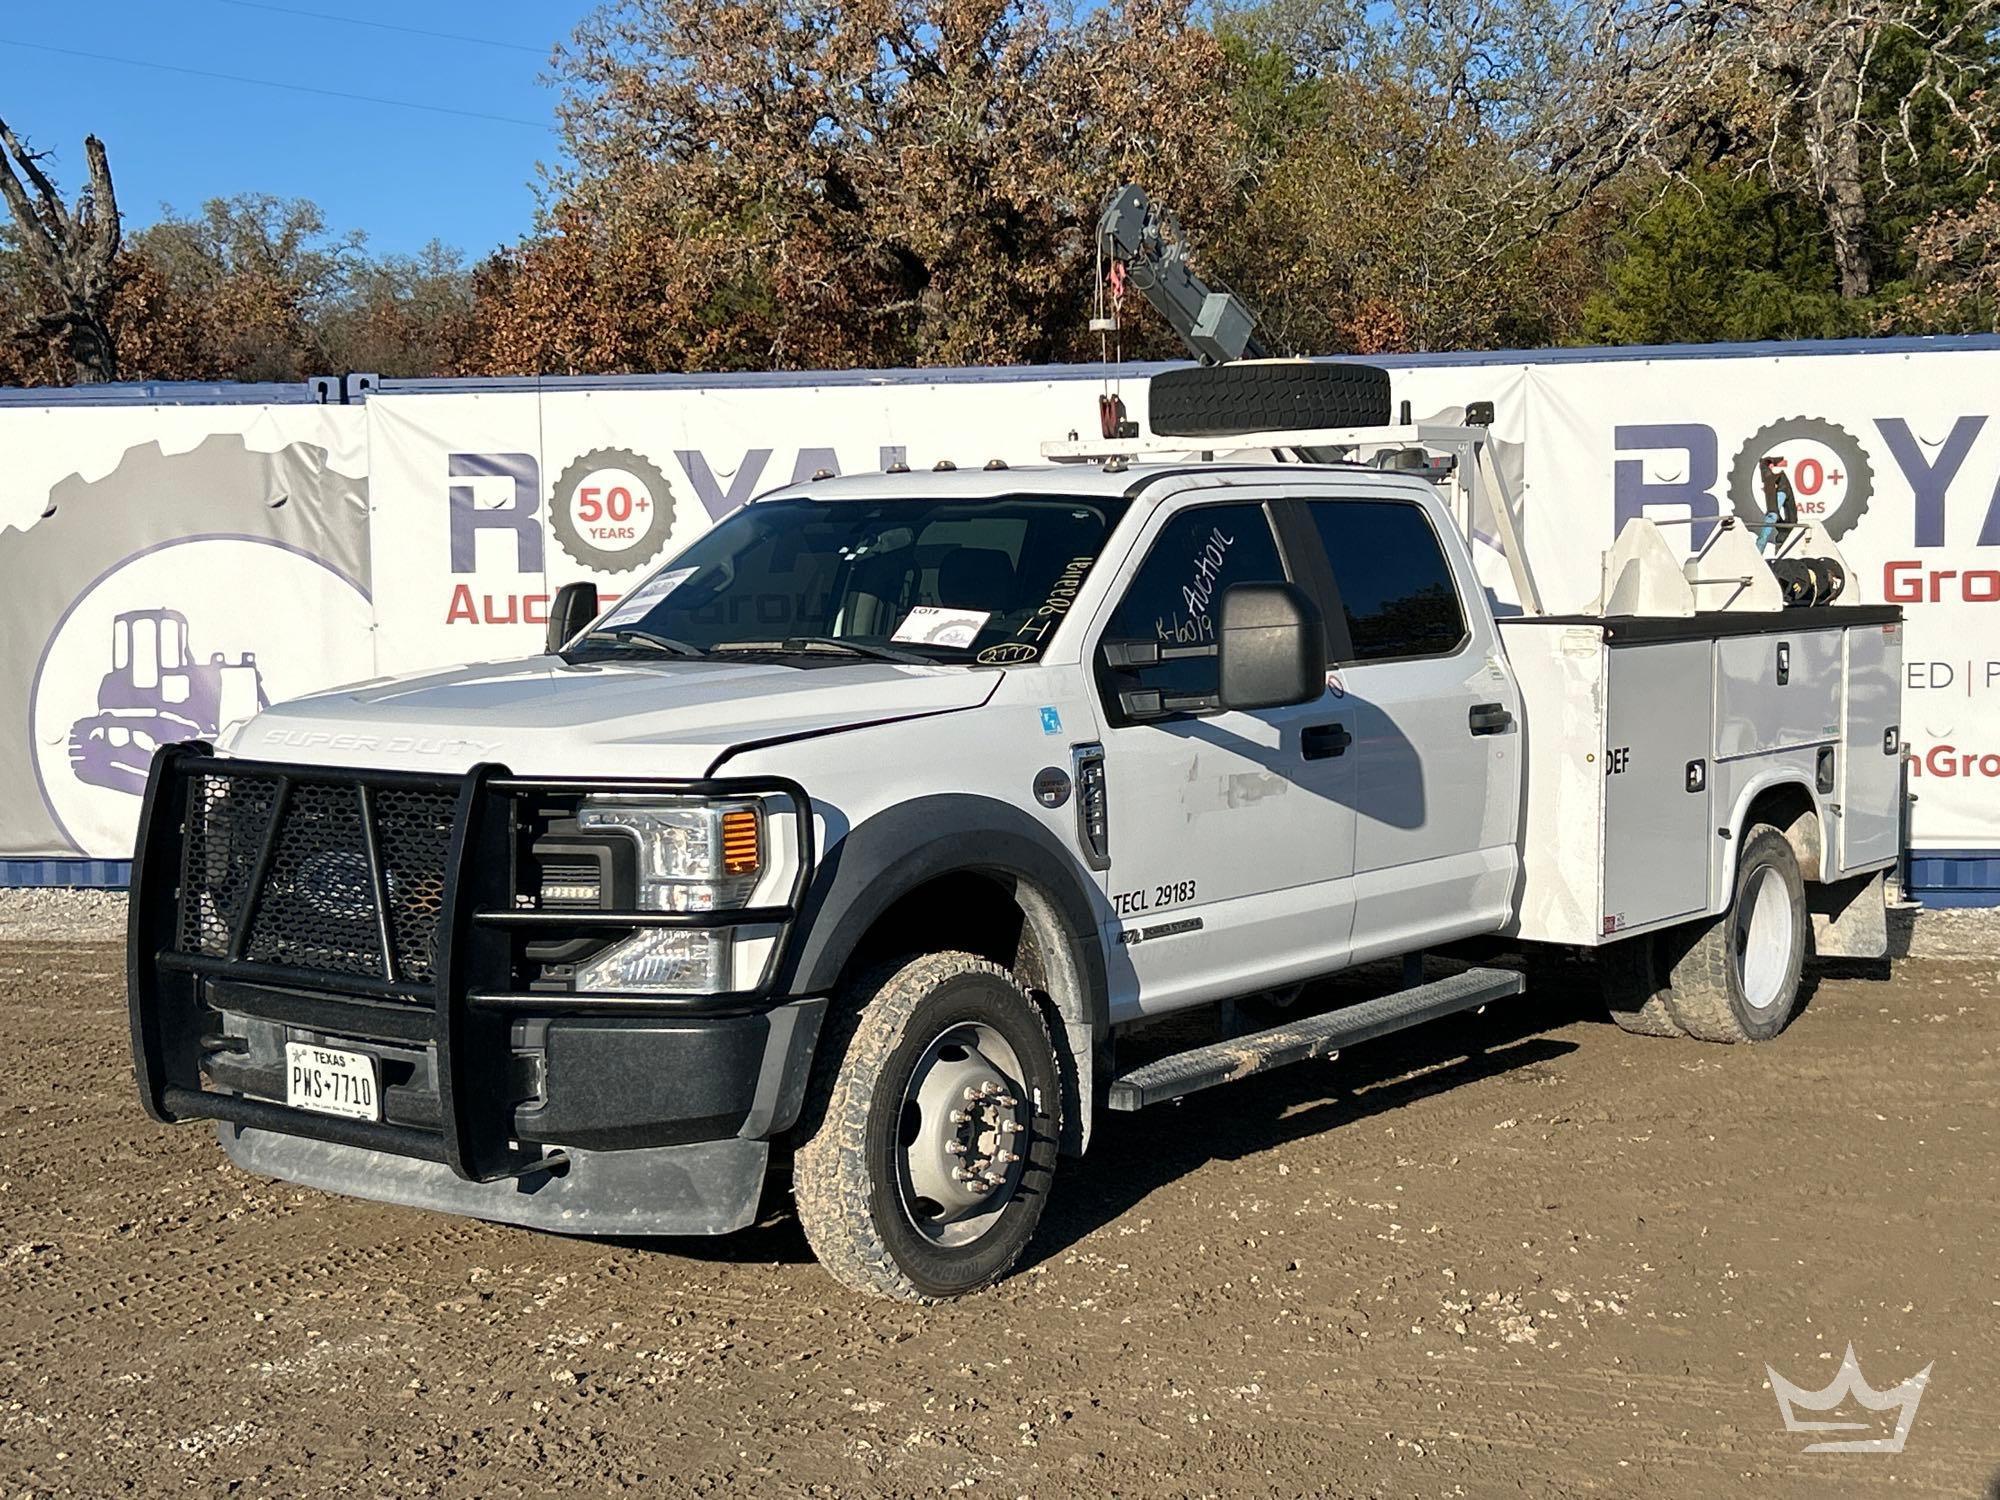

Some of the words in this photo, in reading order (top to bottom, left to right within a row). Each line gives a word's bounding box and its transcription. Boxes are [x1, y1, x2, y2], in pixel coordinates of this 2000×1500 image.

[578, 487, 650, 522] 50+
[1795, 501, 1826, 514] ARS
[589, 527, 635, 539] YEARS
[1902, 662, 1954, 688] ED
[262, 729, 380, 751] SUPER
[386, 737, 504, 757] DUTY
[1606, 746, 1630, 776] DEF
[1112, 889, 1149, 916] TECL
[1154, 879, 1196, 907] 29183
[313, 1051, 346, 1068] TEXAS
[331, 1072, 371, 1106] 7710
